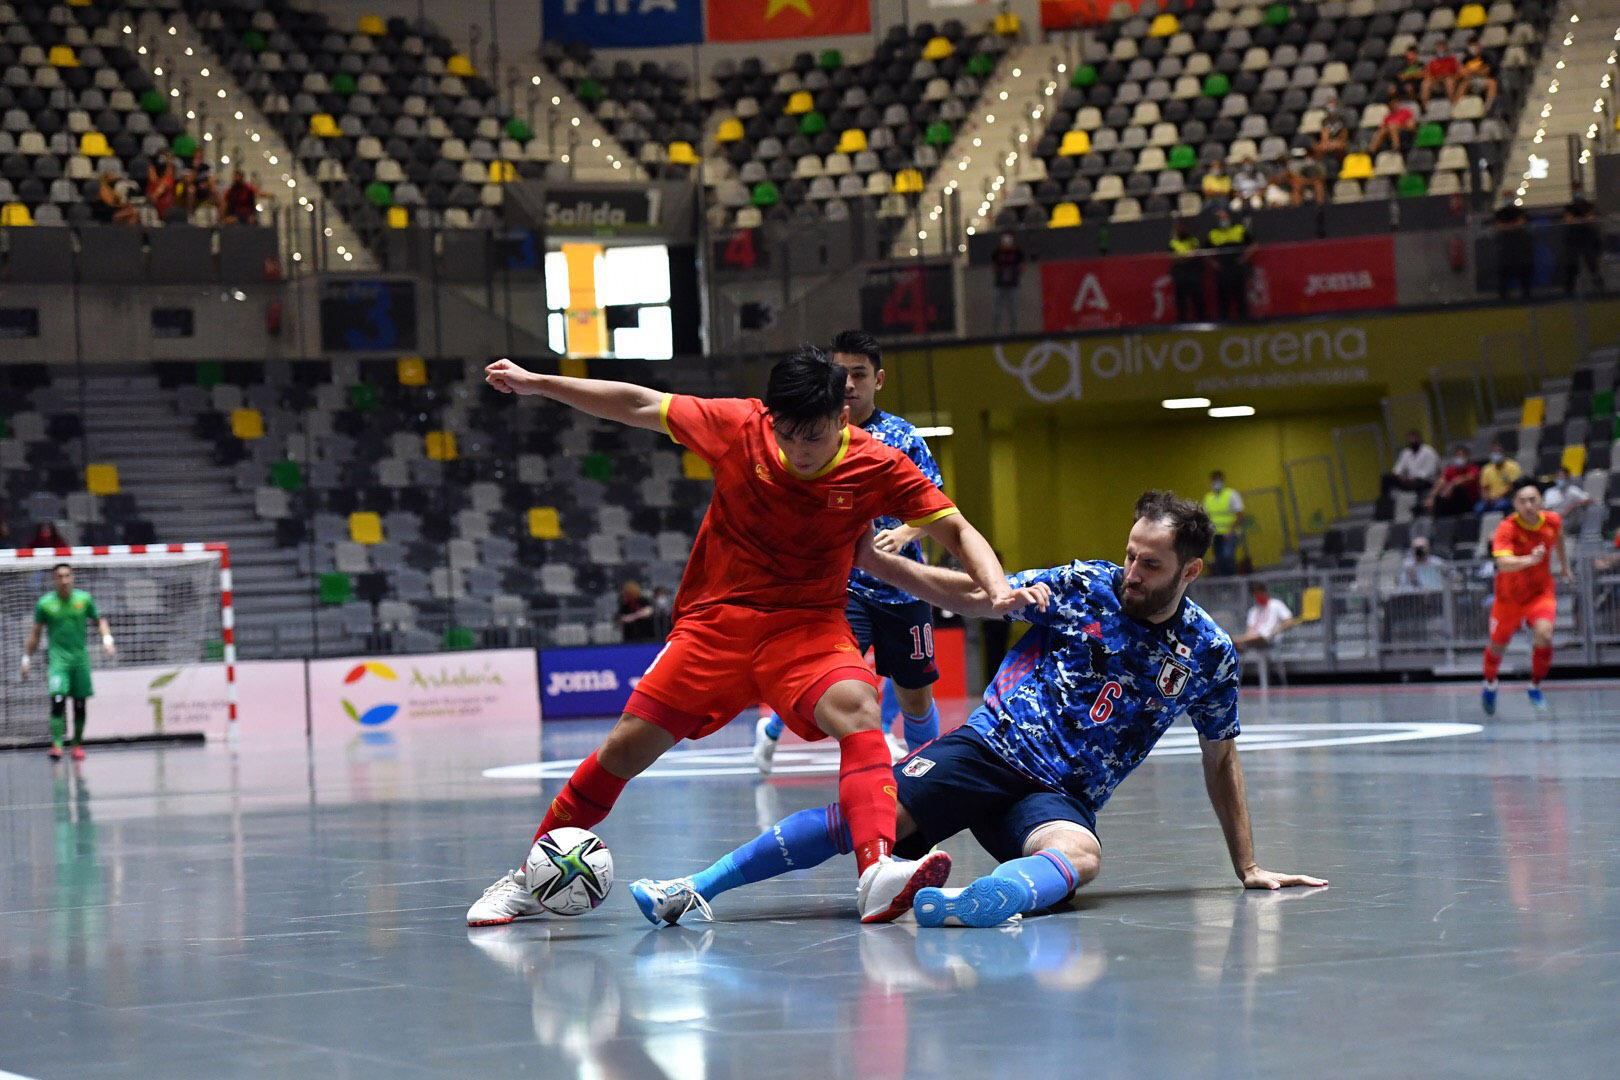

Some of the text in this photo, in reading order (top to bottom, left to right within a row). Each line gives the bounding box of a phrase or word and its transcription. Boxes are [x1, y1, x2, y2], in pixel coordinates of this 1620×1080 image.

[546, 201, 627, 225] Salida
[723, 228, 757, 267] 4
[345, 279, 396, 348] 3
[882, 265, 938, 333] 4
[1091, 327, 1368, 379] olivo arena
[910, 622, 934, 659] 10
[1089, 681, 1122, 724] 6
[773, 825, 795, 867] JAPAN
